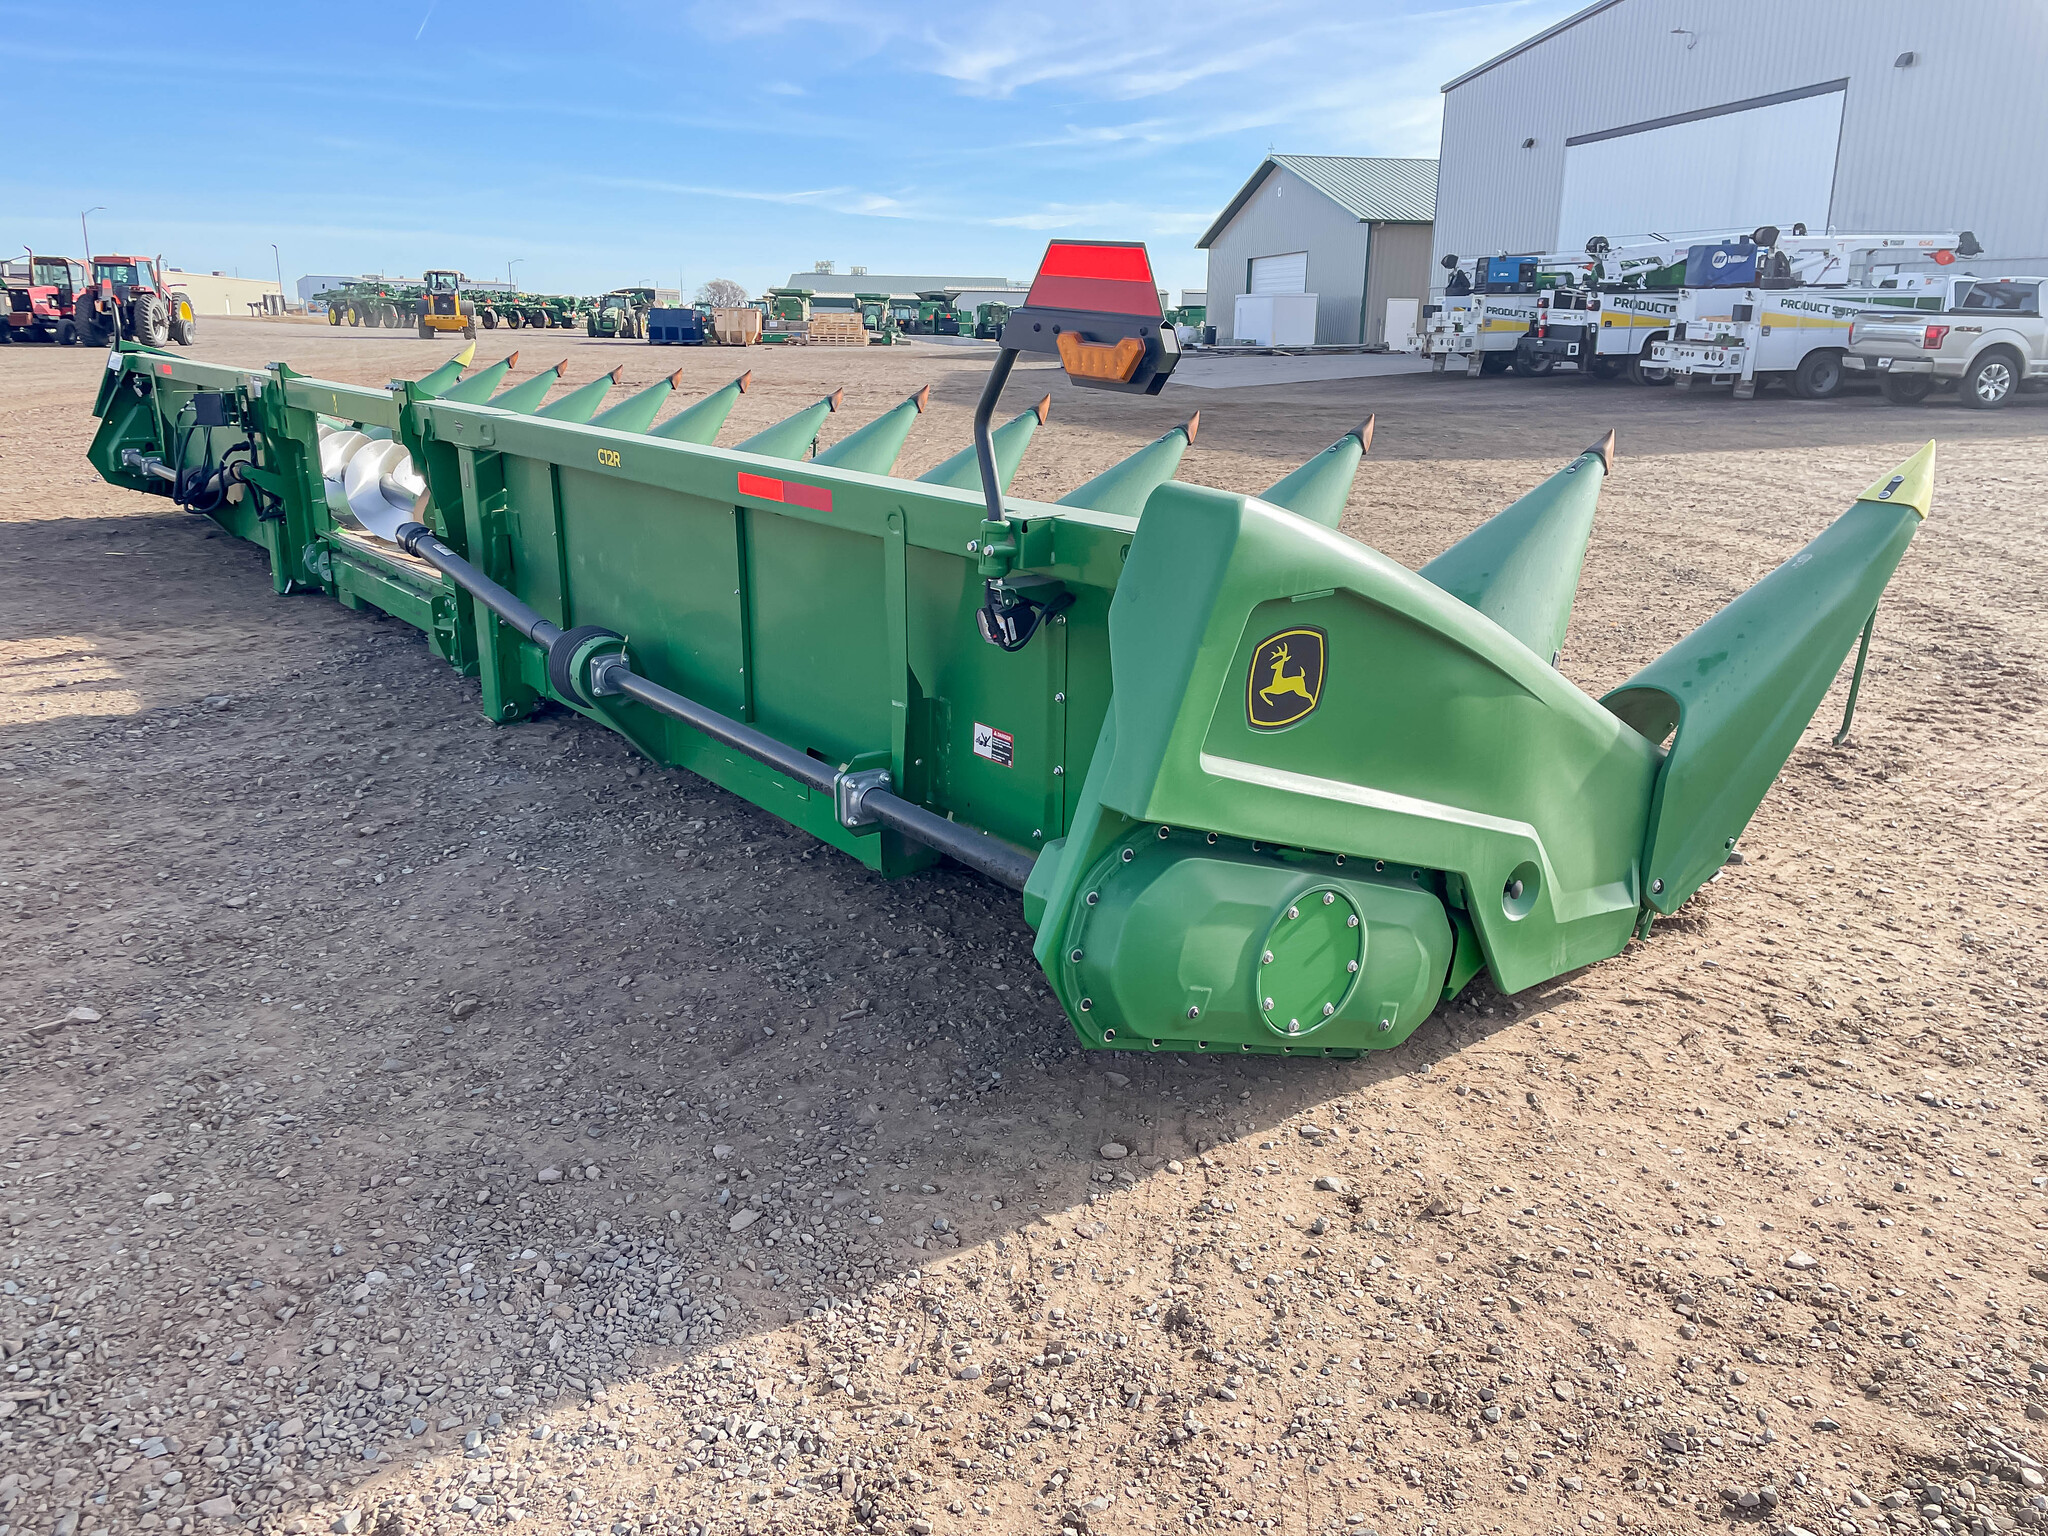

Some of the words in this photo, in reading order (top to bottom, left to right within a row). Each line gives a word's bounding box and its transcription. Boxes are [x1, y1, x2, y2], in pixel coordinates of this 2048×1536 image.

[1613, 297, 1669, 314] PRODUCT
[1781, 298, 1830, 314] PRODUCT
[597, 448, 621, 468] C12R
